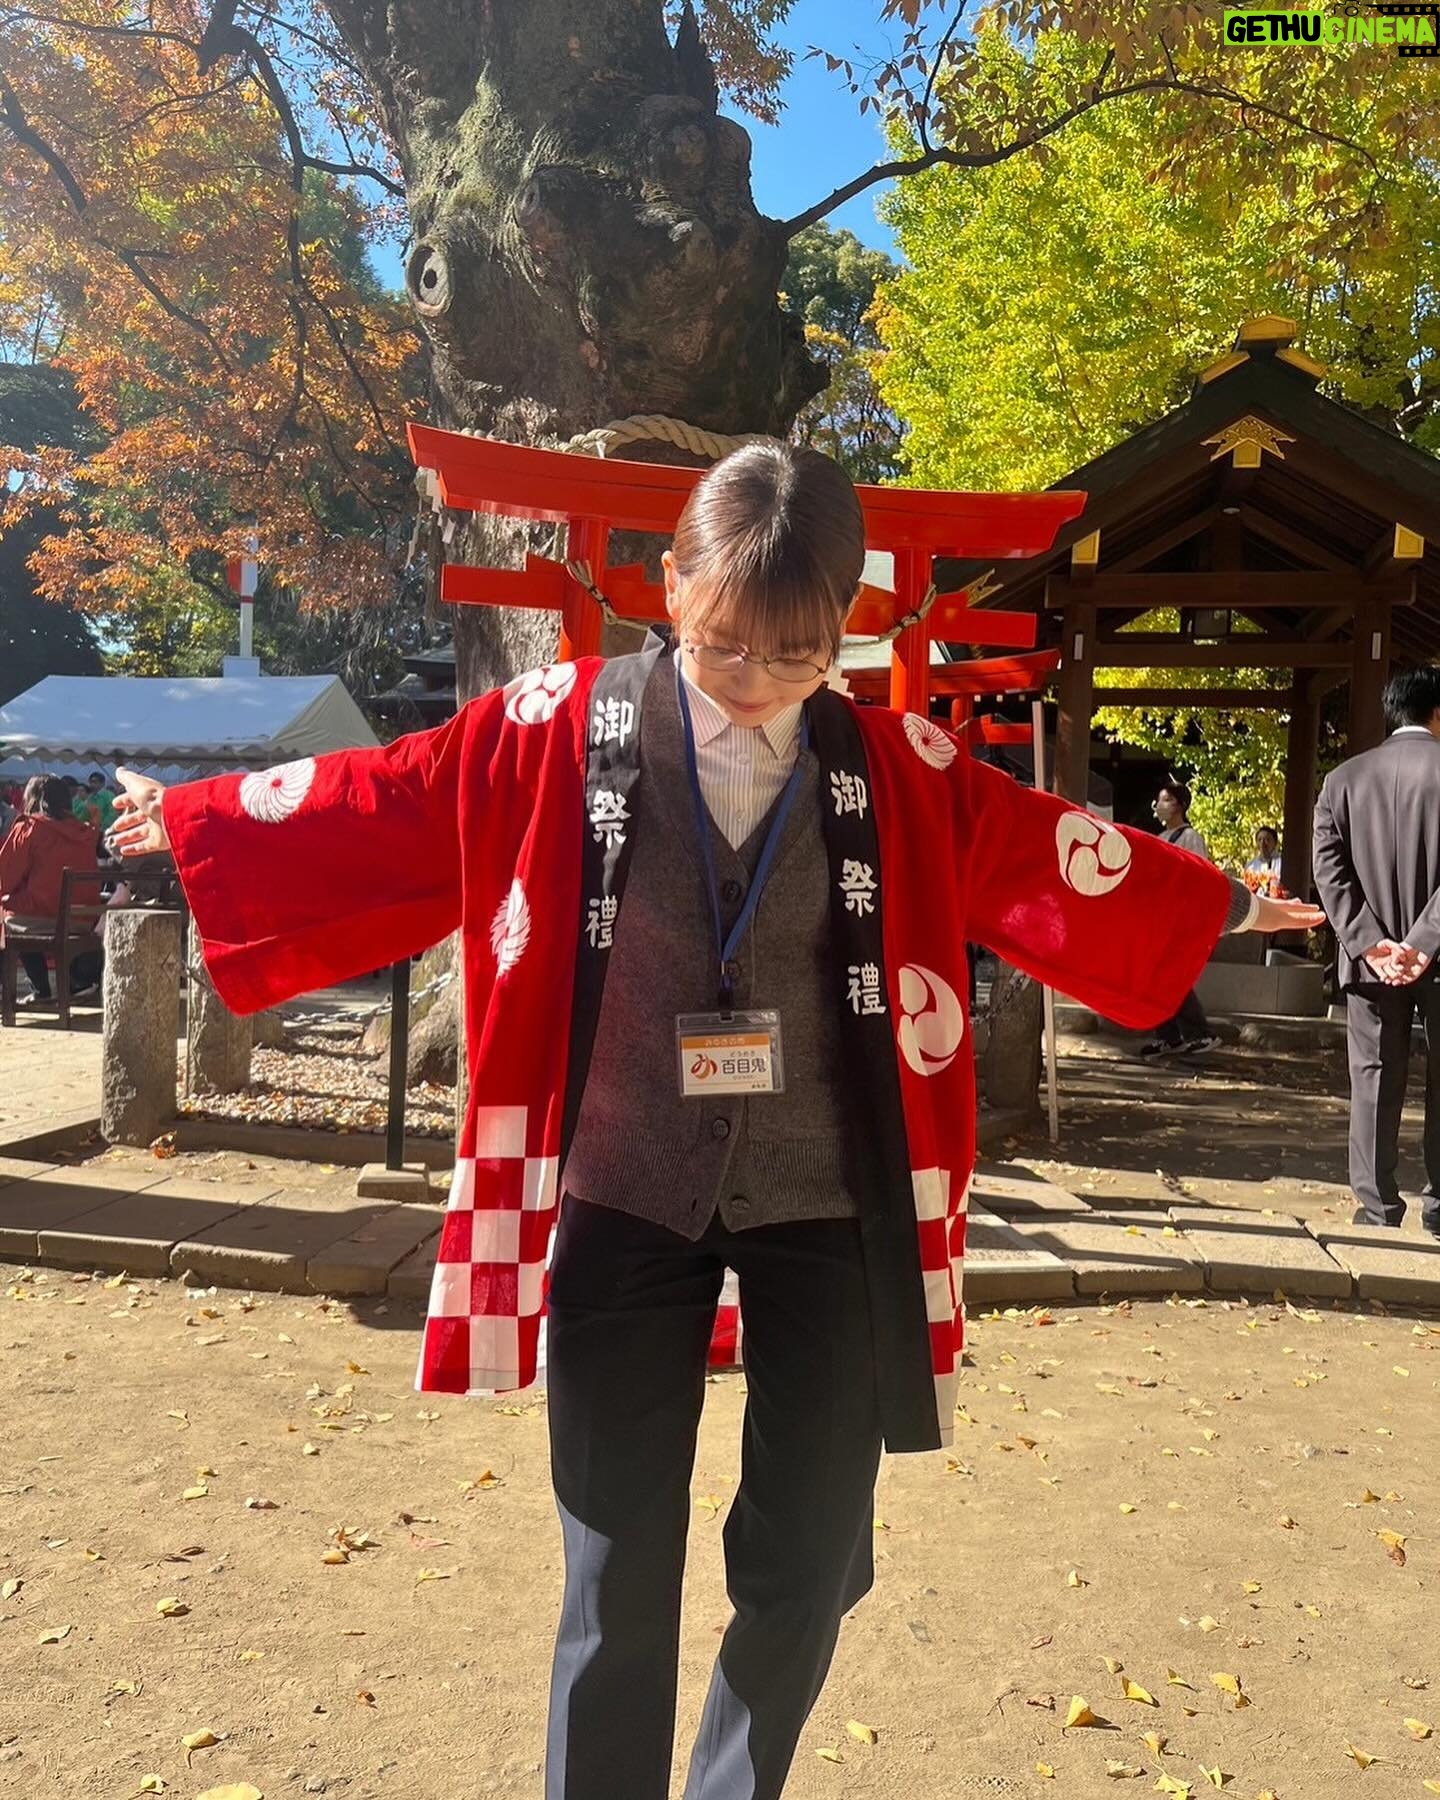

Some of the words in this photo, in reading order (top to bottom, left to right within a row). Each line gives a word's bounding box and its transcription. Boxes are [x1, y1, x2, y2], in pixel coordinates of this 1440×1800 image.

[584, 696, 635, 950] 御祭禮
[829, 769, 887, 1017] 御祭禮
[721, 1058, 767, 1074] 百目鬼
